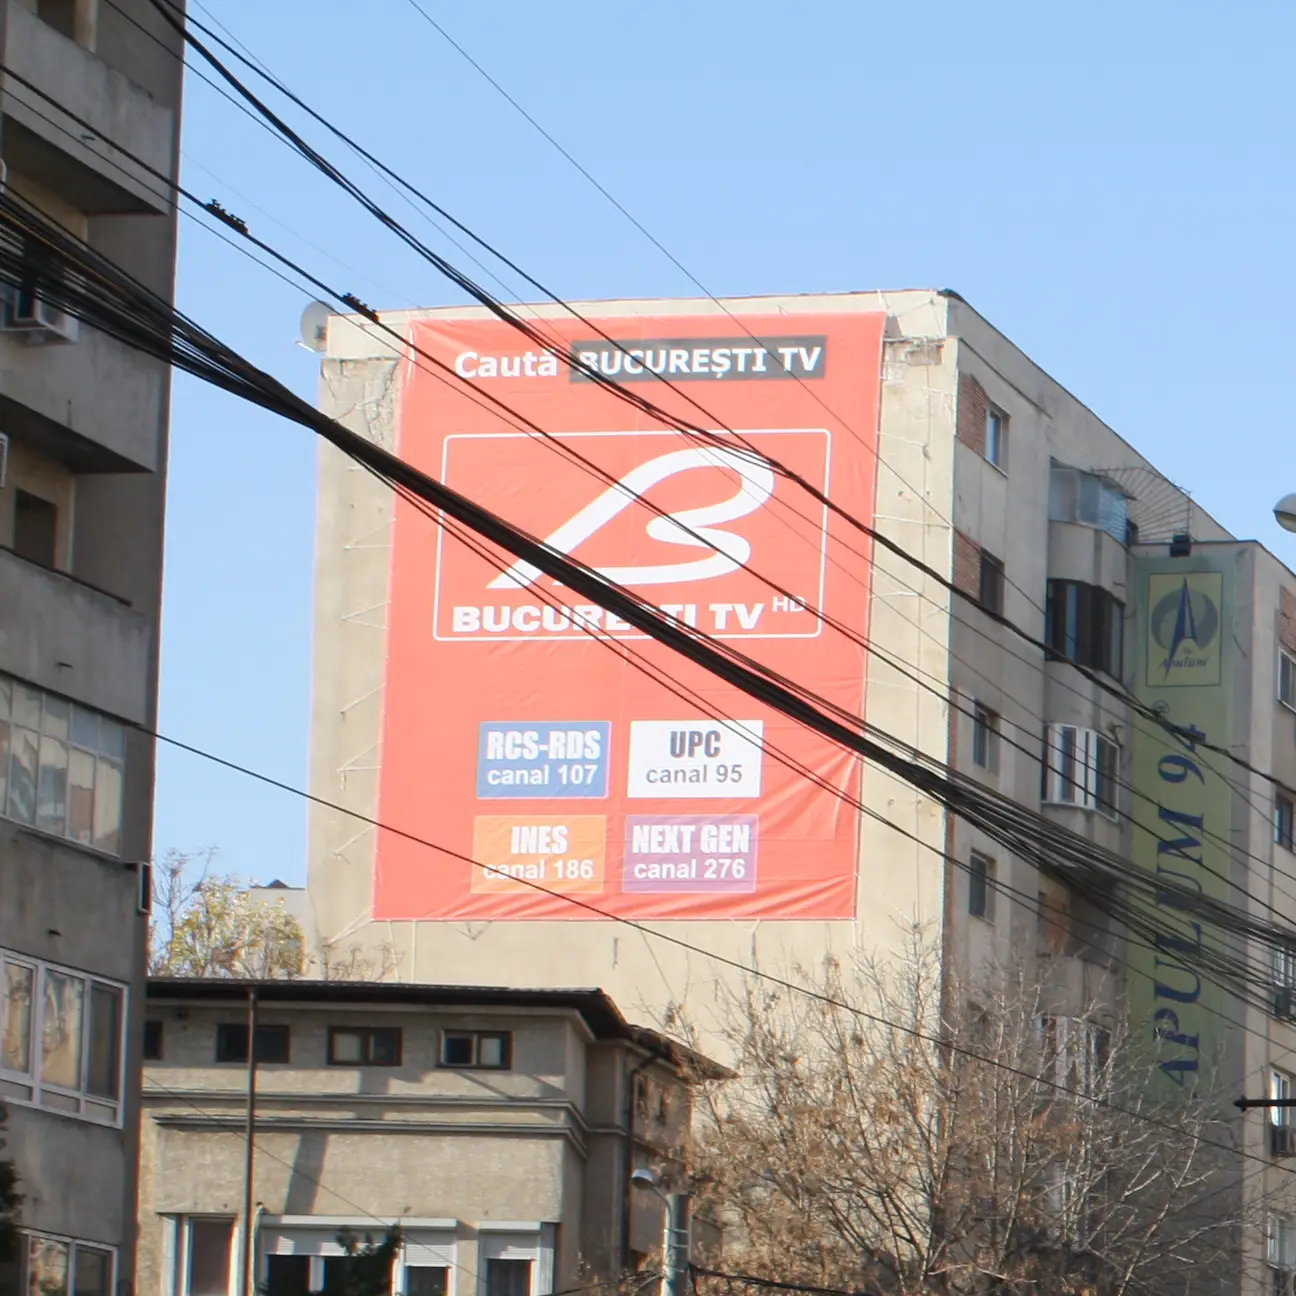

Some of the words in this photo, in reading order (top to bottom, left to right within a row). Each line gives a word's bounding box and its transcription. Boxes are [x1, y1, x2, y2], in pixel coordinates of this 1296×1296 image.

[455, 349, 558, 378] Caută
[778, 347, 823, 373] TV
[452, 602, 697, 633] BUCURETI
[709, 602, 764, 630] TV
[772, 596, 807, 613] HD
[486, 729, 601, 760] RCS-RDS
[669, 730, 722, 759] UPC
[1156, 723, 1207, 786] 94
[487, 764, 549, 785] canal
[558, 764, 598, 785] 107
[645, 764, 708, 784] canal
[715, 764, 743, 784] 95
[510, 825, 569, 855] INES
[631, 824, 696, 855] NEXT
[700, 824, 750, 854] GEN
[482, 859, 545, 880] canal
[553, 859, 594, 880] 186
[634, 858, 697, 880] canal
[703, 858, 746, 879] 276
[1152, 800, 1204, 1088] APULUM
